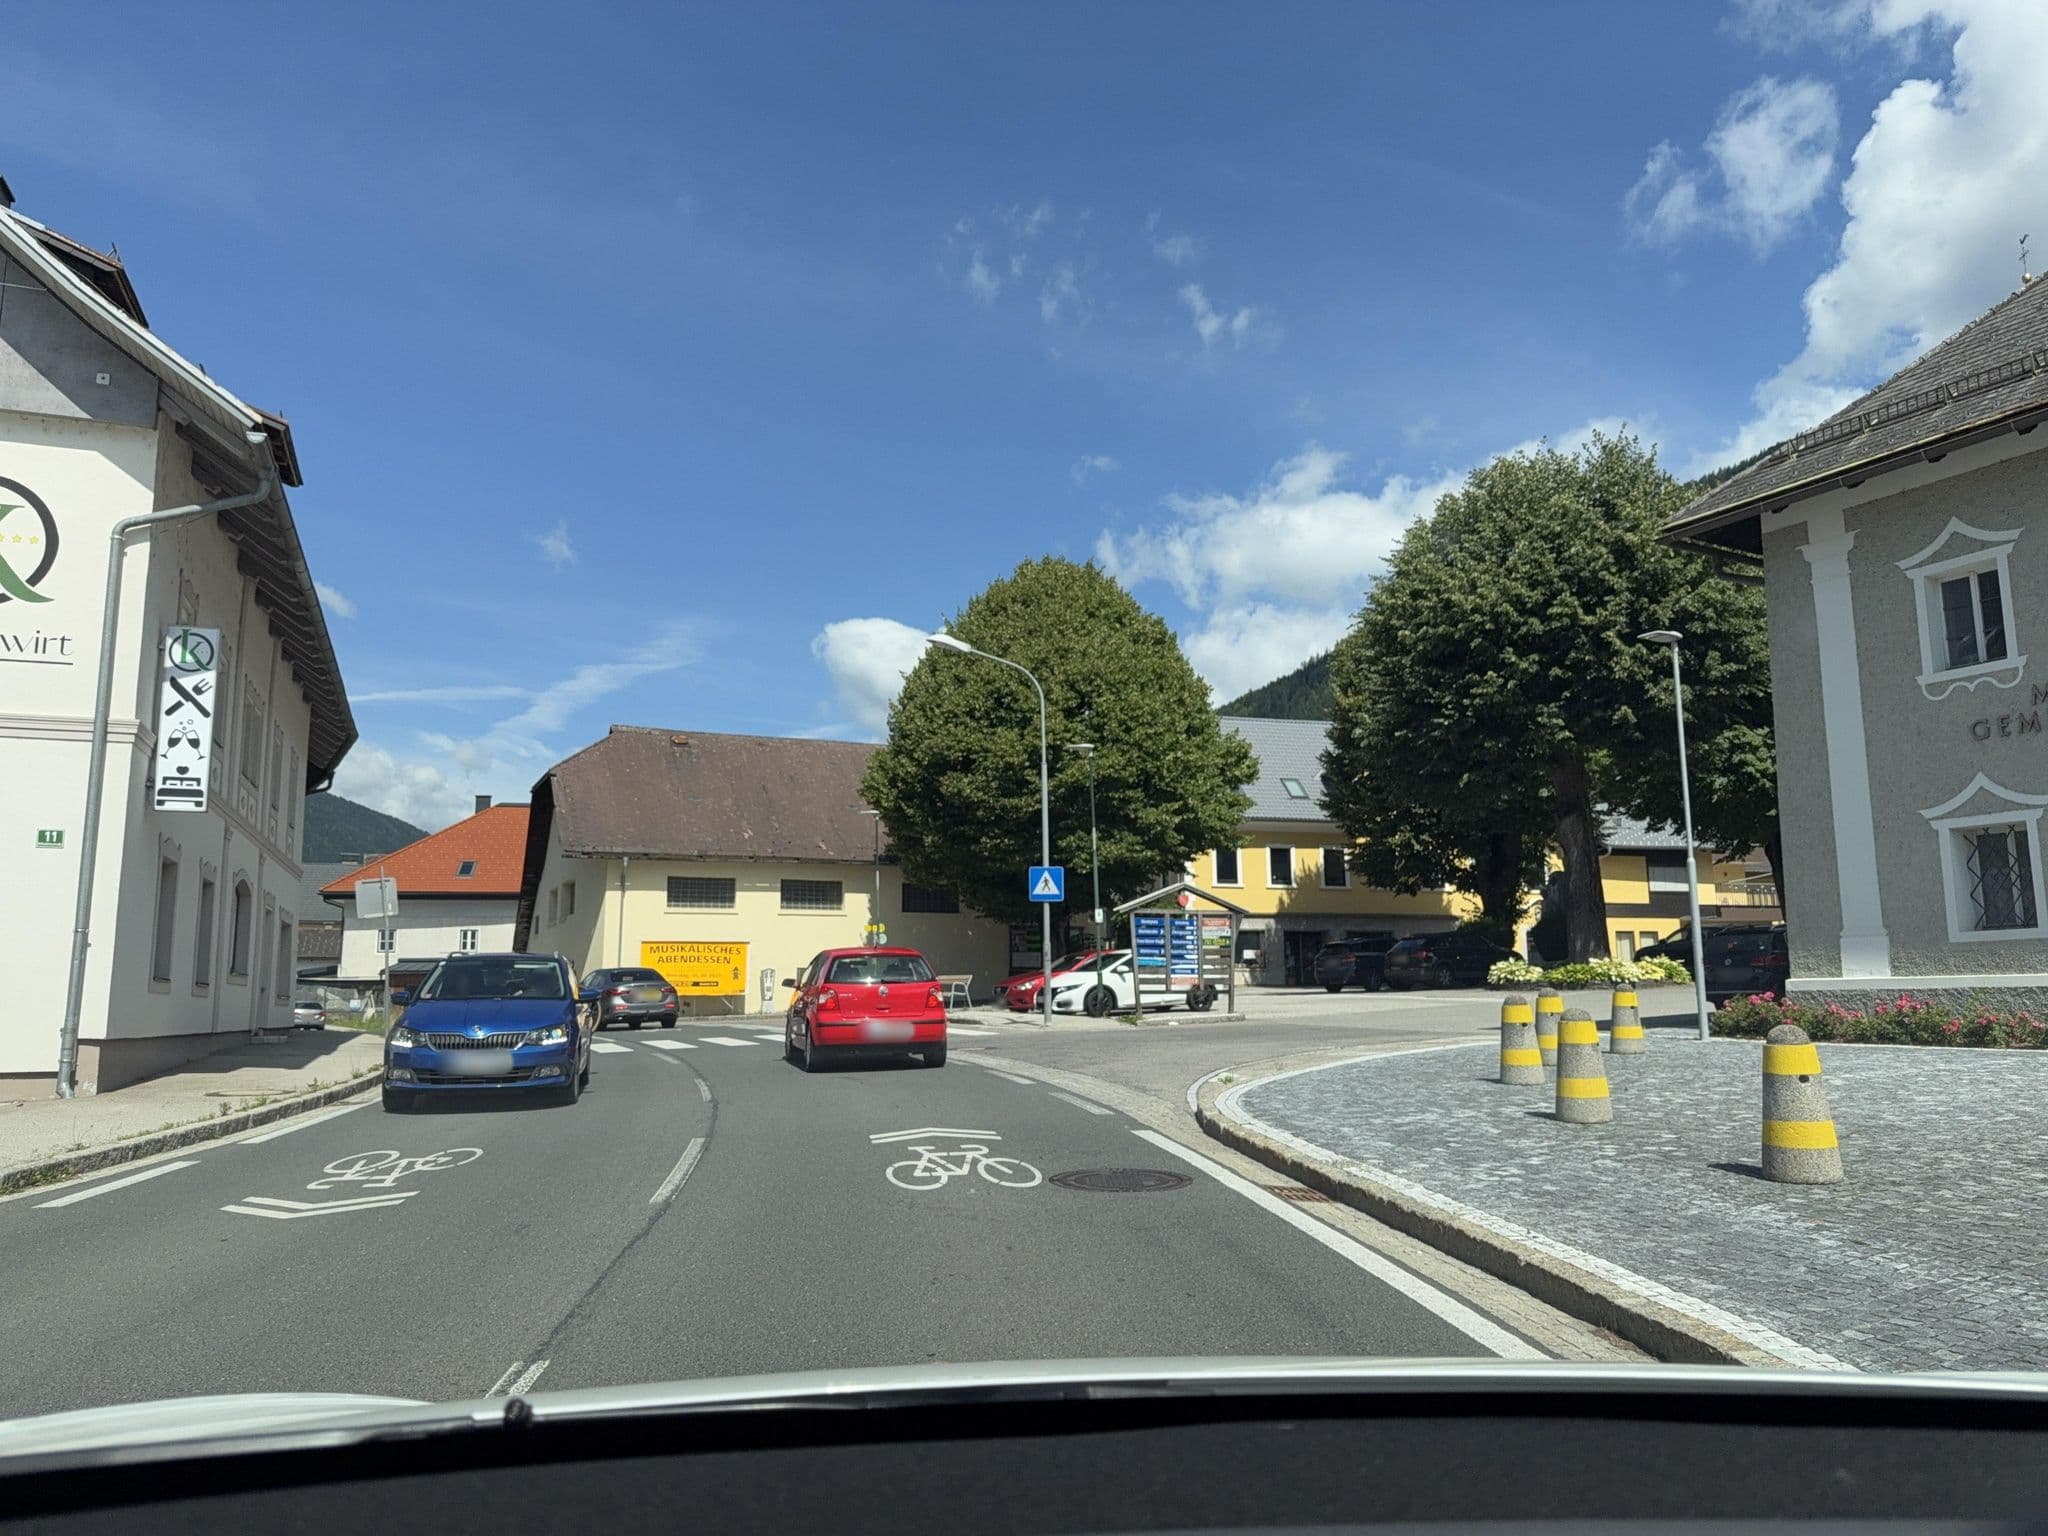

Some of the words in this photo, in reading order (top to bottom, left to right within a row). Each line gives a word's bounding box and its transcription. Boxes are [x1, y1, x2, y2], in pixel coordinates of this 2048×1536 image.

[45, 831, 57, 842] 11
[648, 945, 742, 955] MUSIKALISCHES
[657, 955, 731, 964] ABENDESSEN
